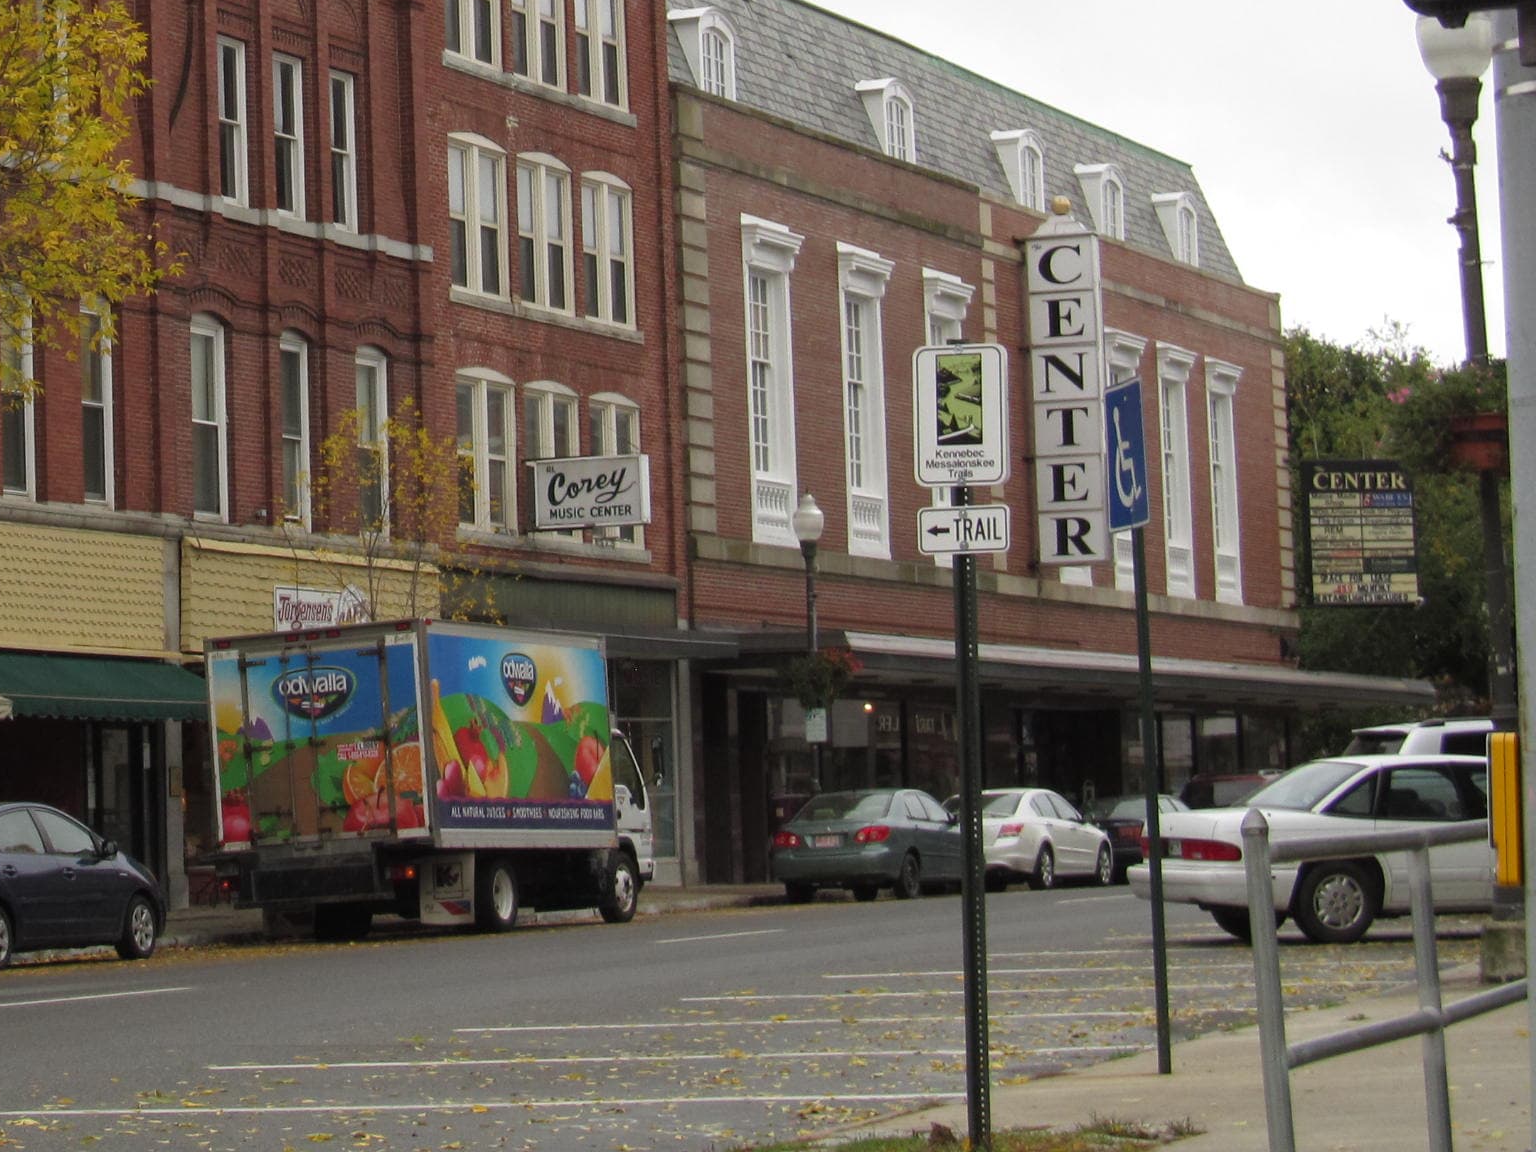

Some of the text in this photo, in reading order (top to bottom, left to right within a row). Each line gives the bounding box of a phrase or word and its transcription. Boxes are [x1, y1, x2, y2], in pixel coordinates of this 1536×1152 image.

[1038, 244, 1096, 557] CENTER
[935, 449, 984, 458] Kennebec
[925, 459, 995, 468] Messalonskee
[948, 468, 974, 478] Trails
[1313, 472, 1406, 490] CENTER
[547, 467, 636, 506] Corey
[550, 504, 632, 520] MUSIC CENTER
[953, 517, 1002, 541] TRAIL
[503, 660, 534, 680] odwalla
[279, 672, 347, 696] odwalla
[451, 807, 461, 818] ALL
[462, 806, 485, 818] NATURAL
[486, 807, 505, 818] JUICES
[512, 807, 543, 819] SMOOTHIES
[548, 808, 579, 819] NOURISHING
